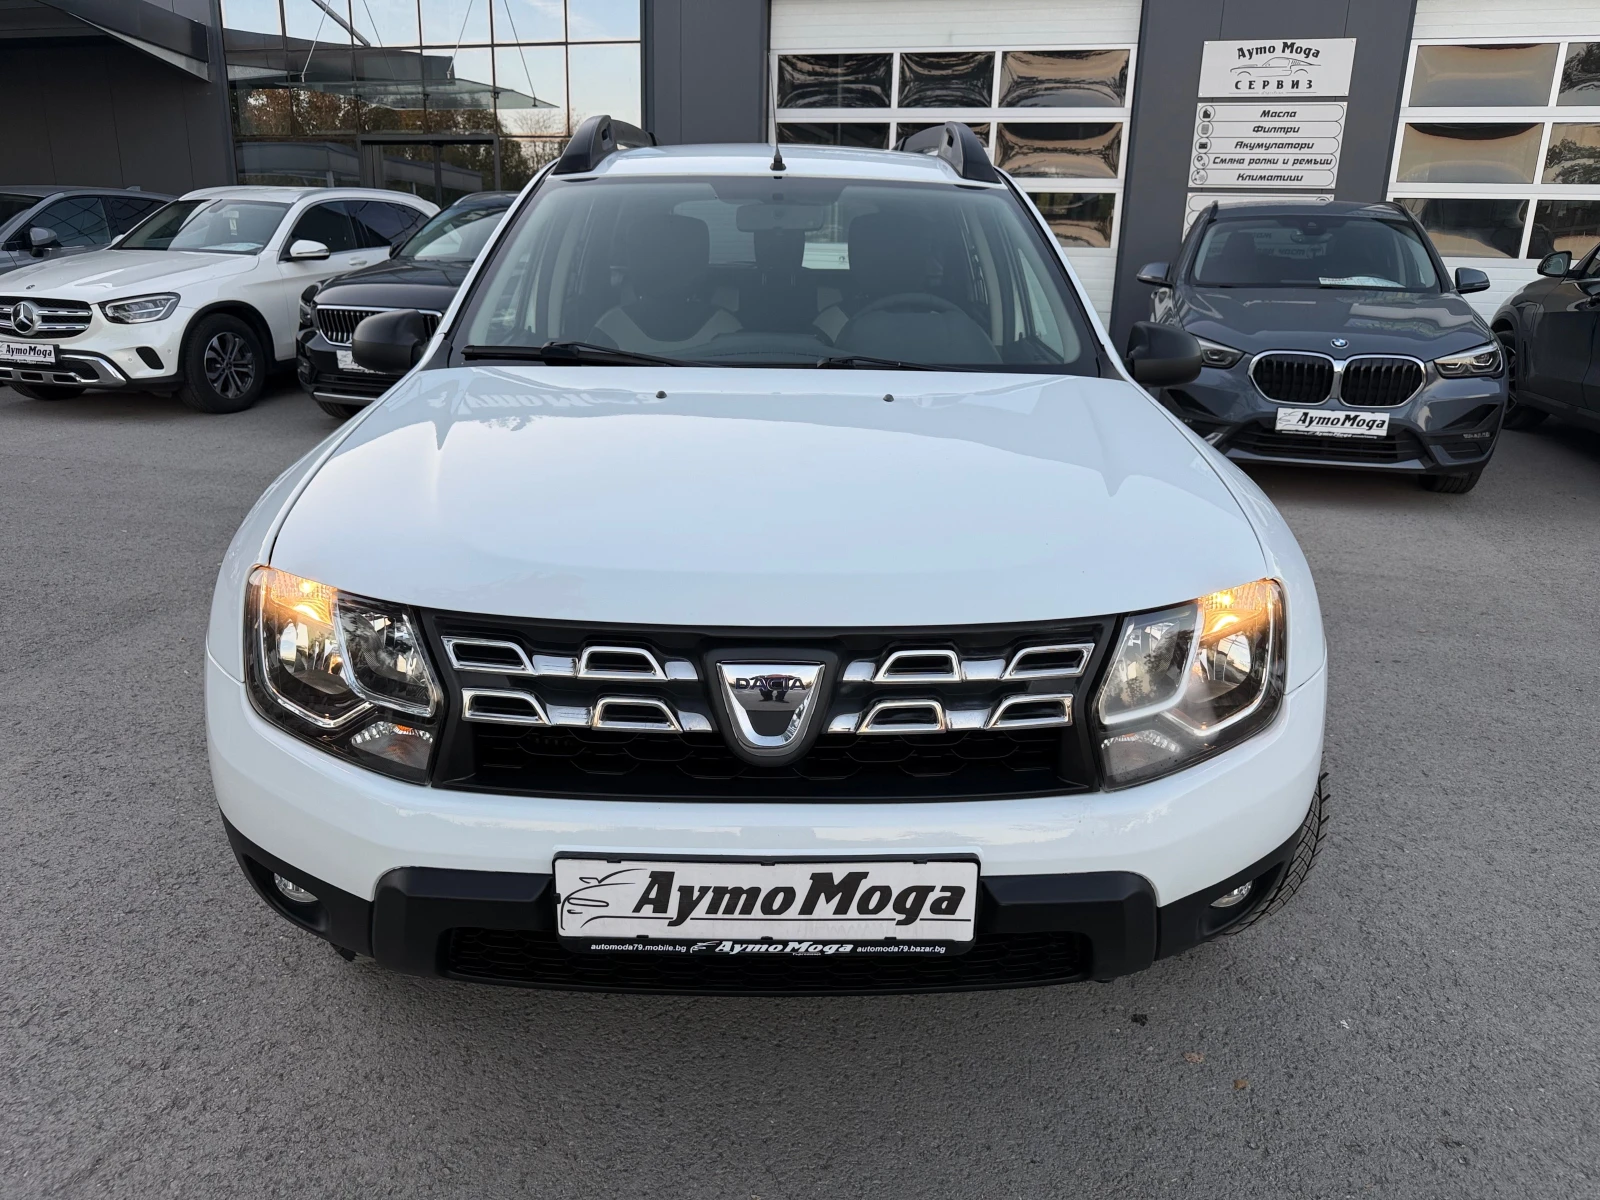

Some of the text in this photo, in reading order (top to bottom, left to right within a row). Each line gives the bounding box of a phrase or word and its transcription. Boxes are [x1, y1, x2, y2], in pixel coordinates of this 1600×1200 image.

[1237, 41, 1320, 60] Ауто Мода
[1234, 79, 1313, 90] СЕРВИЗ
[1260, 109, 1297, 118] Масла
[1252, 125, 1300, 135] Филтри
[1234, 141, 1315, 151] Акумулатори
[1212, 156, 1246, 165] Смяна
[1248, 158, 1280, 166] ролки
[735, 677, 806, 691] DACIA
[590, 943, 687, 954] automoda79.mobile.bg
[856, 945, 946, 954] automoda79.bazar.bg
